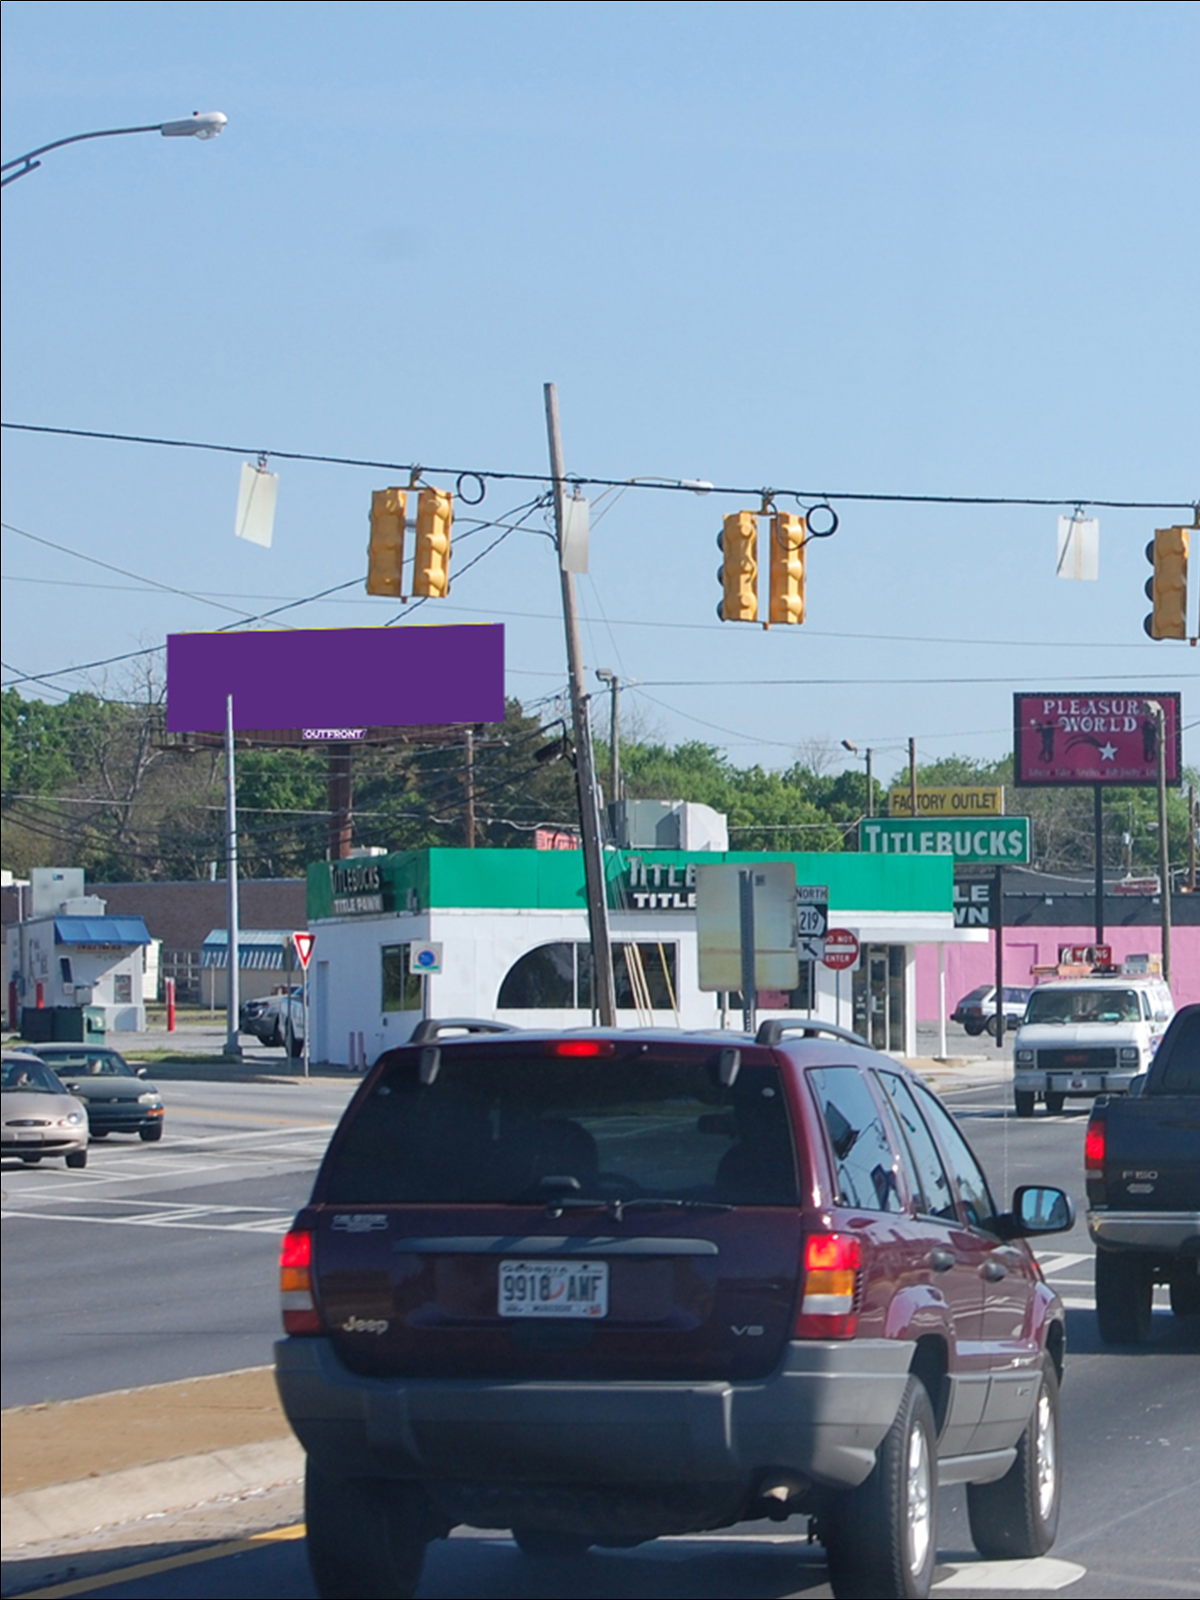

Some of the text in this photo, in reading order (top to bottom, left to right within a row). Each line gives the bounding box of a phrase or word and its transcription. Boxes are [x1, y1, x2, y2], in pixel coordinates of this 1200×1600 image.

[1043, 700, 1148, 715] PLEASUR
[1058, 716, 1137, 732] WORLD
[304, 730, 363, 739] OUTFRONT
[951, 793, 997, 809] OUTLET
[796, 888, 828, 899] NORTH
[334, 898, 356, 914] TITLE
[800, 911, 819, 930] 219
[838, 935, 853, 943] NOT
[503, 1275, 551, 1301] 9918
[343, 1316, 388, 1335] Jeep
